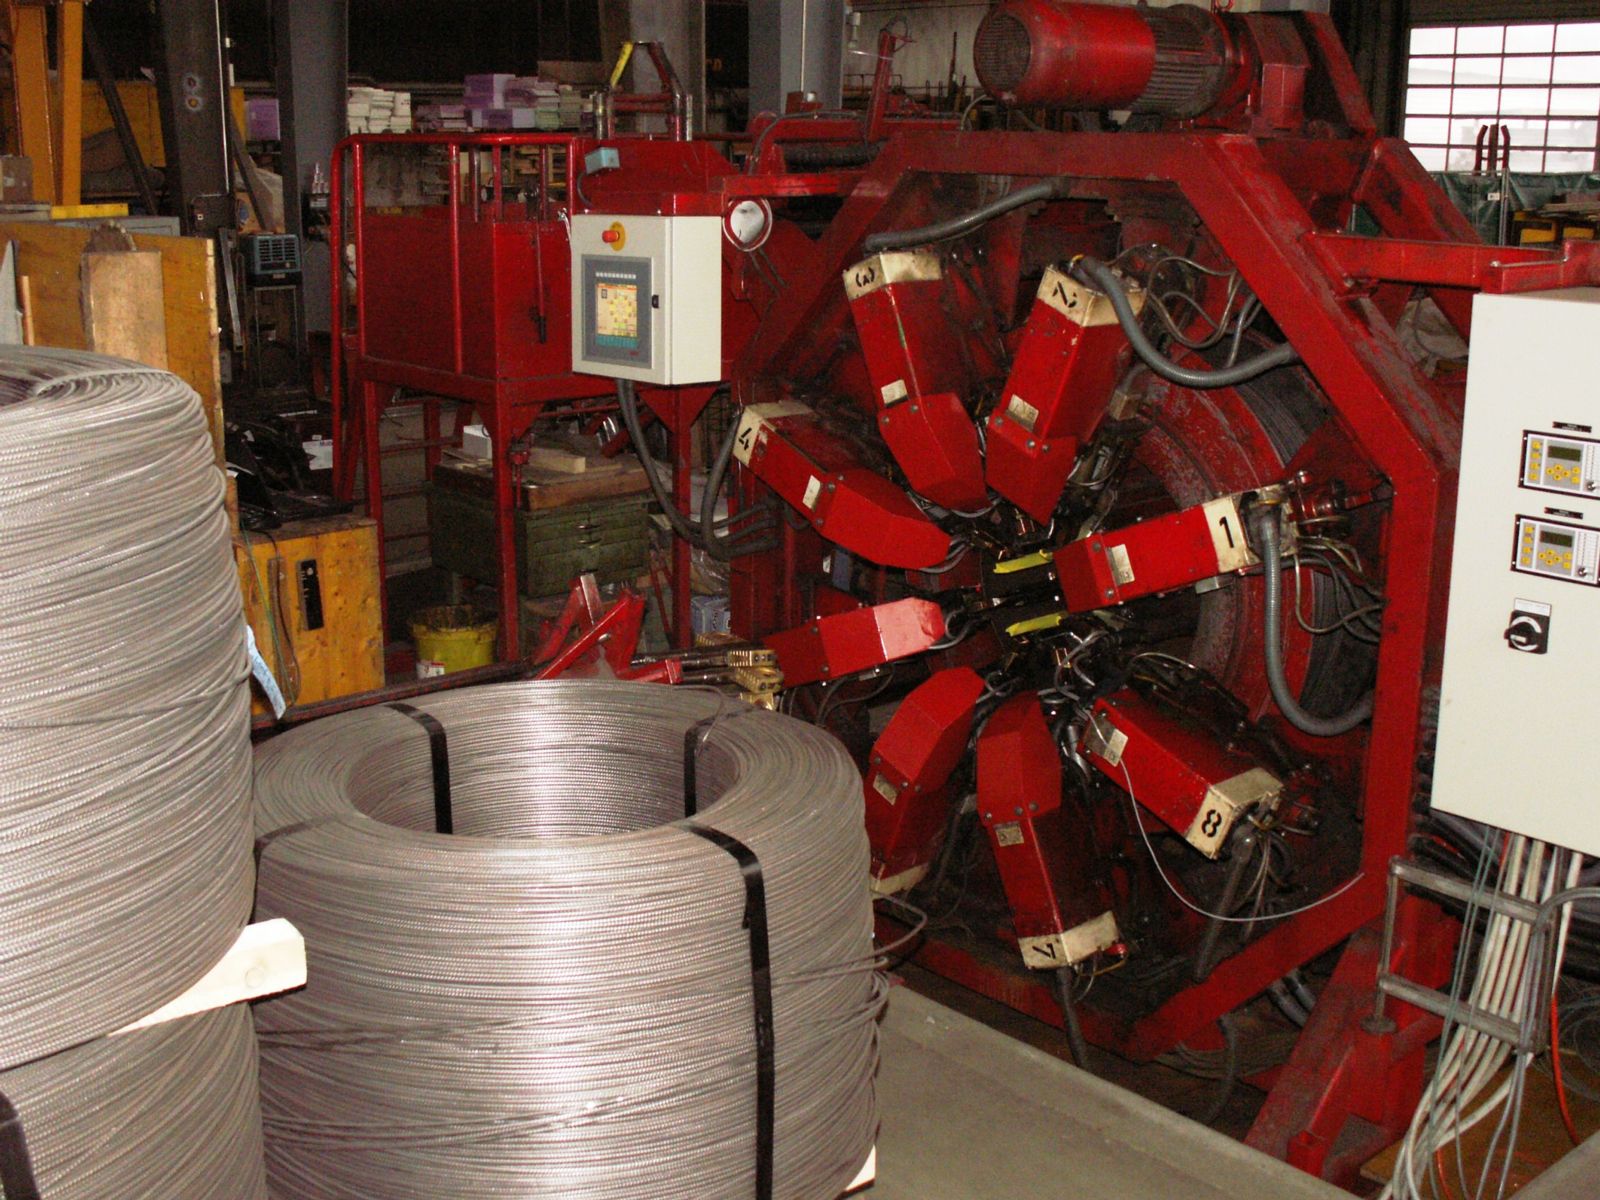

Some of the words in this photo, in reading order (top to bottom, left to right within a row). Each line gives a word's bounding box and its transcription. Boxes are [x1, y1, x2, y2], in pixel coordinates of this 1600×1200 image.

[1052, 281, 1078, 308] 2
[738, 427, 752, 451] 4
[1219, 516, 1234, 549] 1
[1201, 809, 1223, 838] 8
